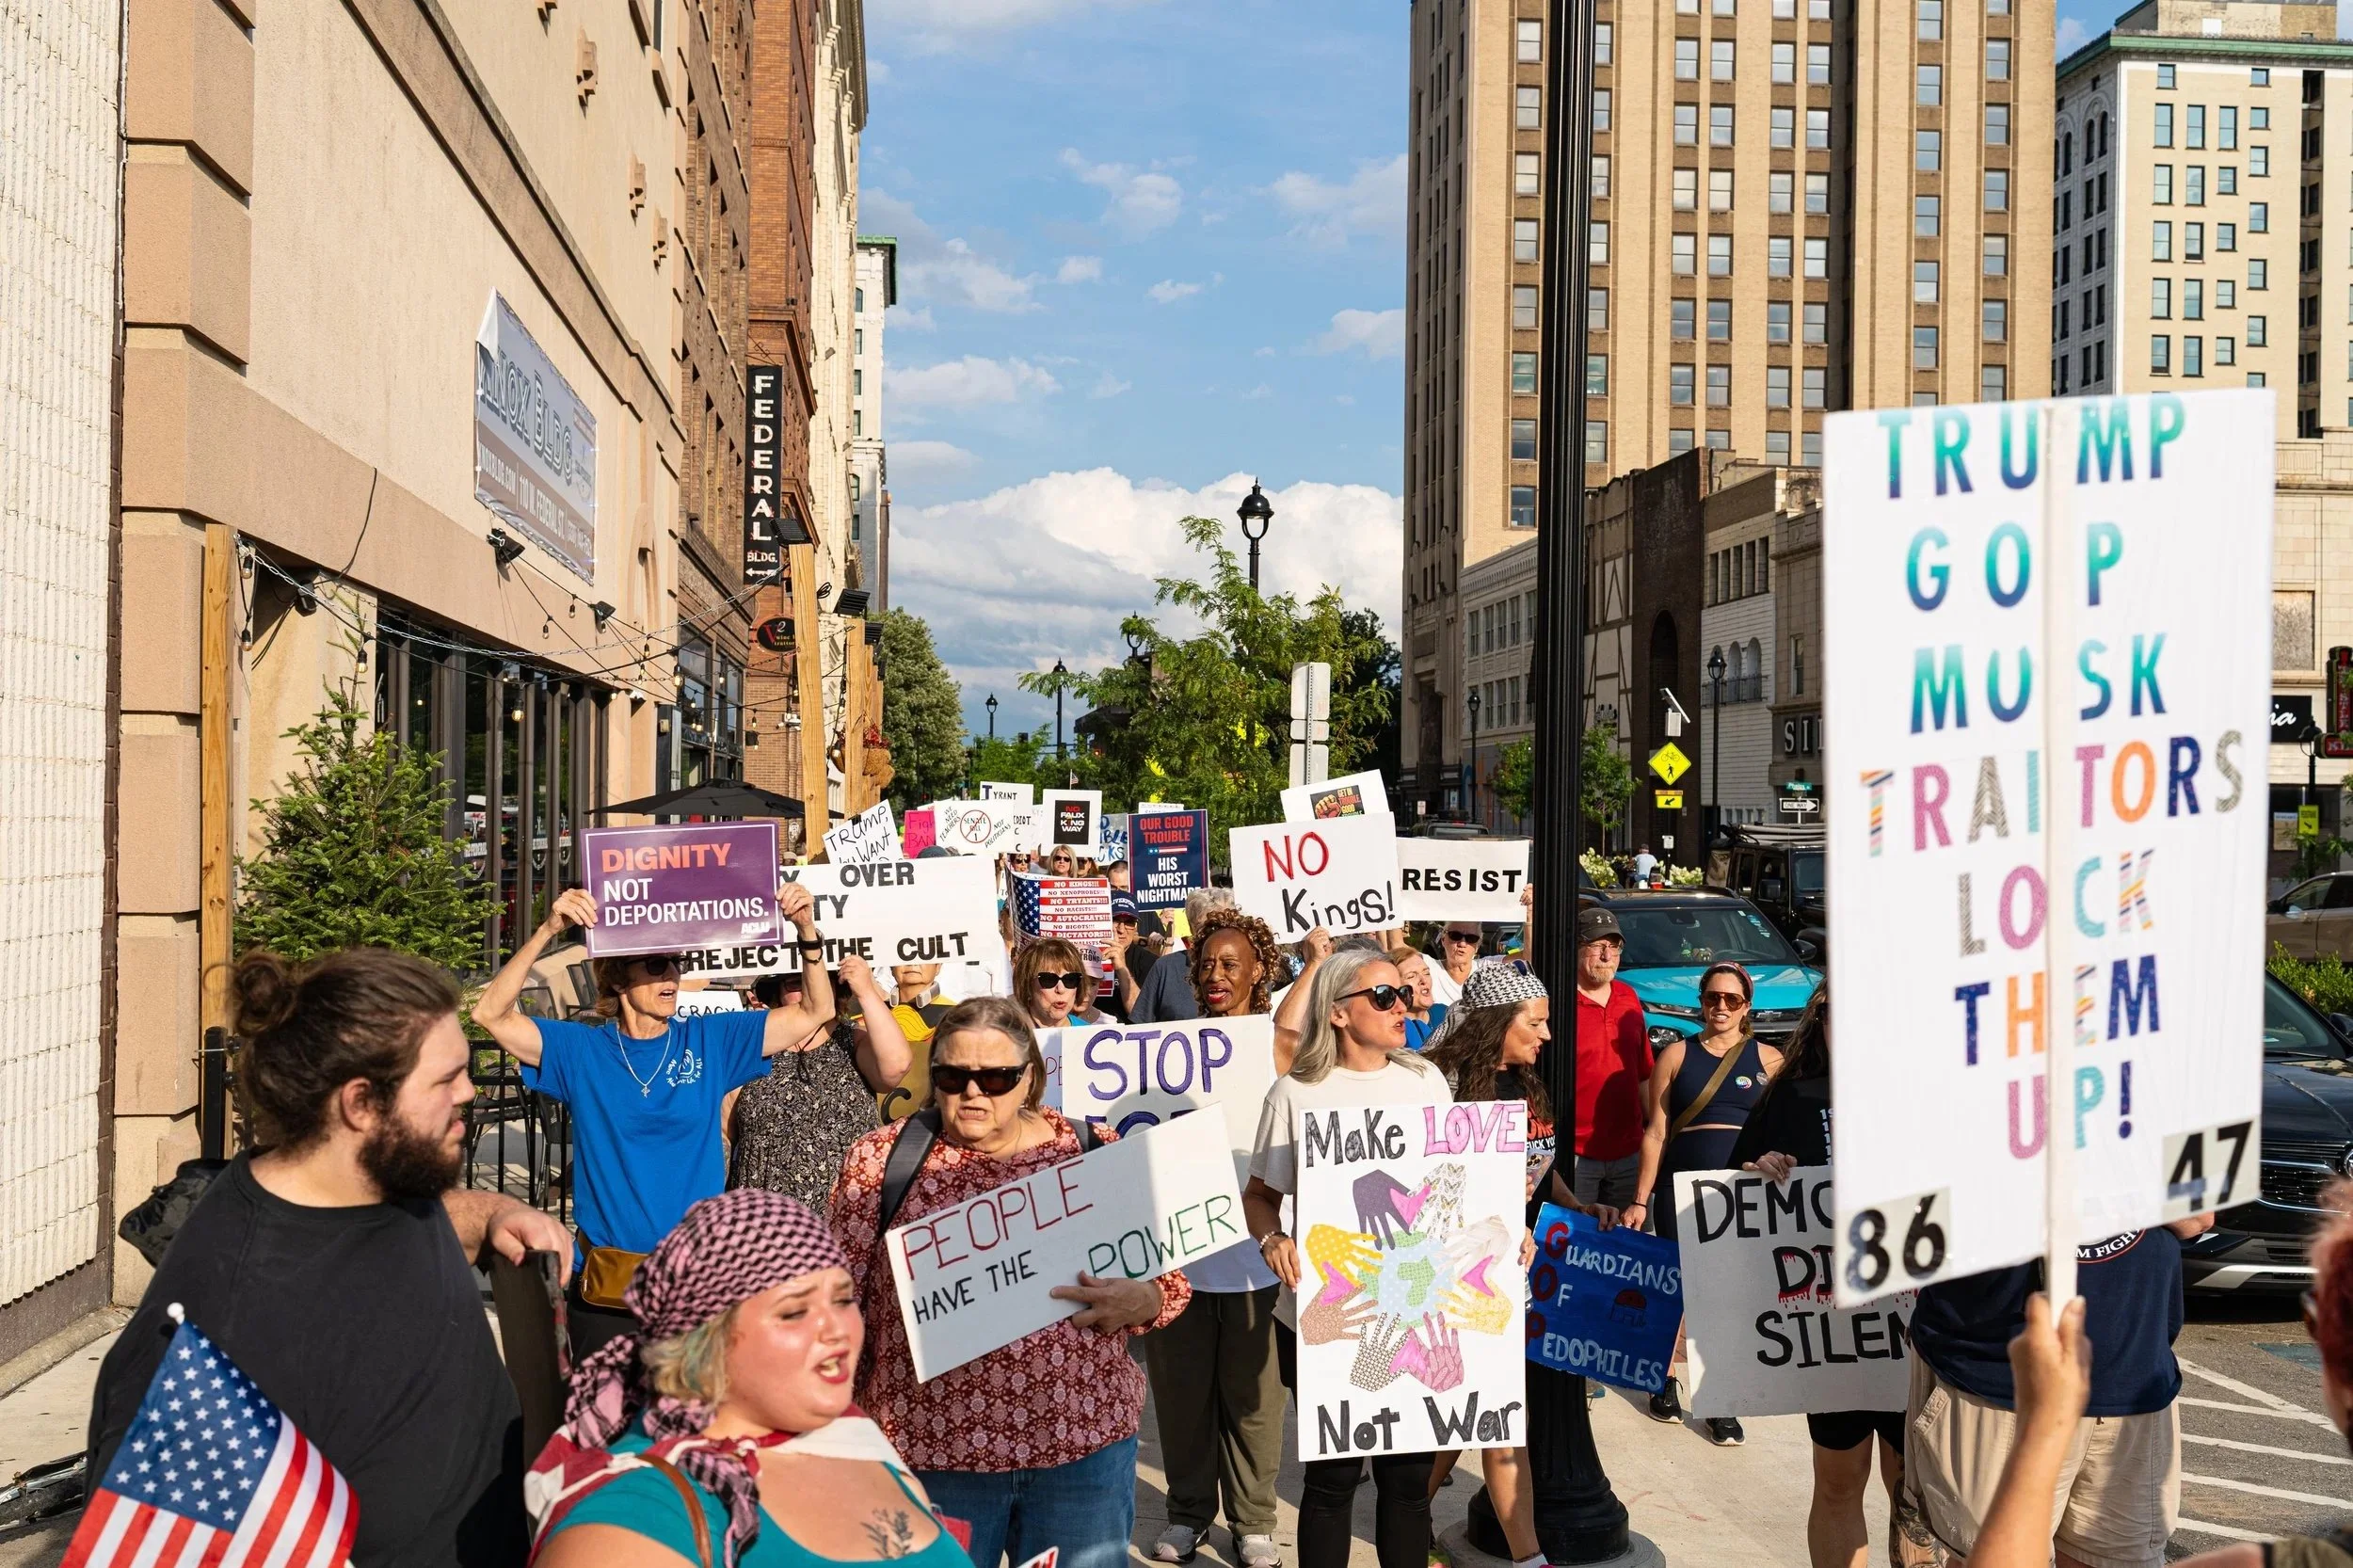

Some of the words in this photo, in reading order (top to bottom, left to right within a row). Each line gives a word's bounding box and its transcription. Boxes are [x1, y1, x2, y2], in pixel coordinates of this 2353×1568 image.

[752, 376, 775, 541] FEDERAL
[1879, 395, 2185, 499] TRUMP
[747, 552, 777, 563] BLDG.
[1906, 520, 2123, 612] GOP
[1910, 632, 2168, 735] MUSK
[1140, 818, 1161, 830] OUR
[1164, 815, 1194, 829] GOOD
[1860, 729, 2244, 857] TRAITORS
[601, 843, 732, 872] DIGNITY
[1144, 829, 1191, 844] TROUBLE
[1158, 856, 1177, 872] HIS
[1263, 832, 1329, 883] NO
[603, 878, 653, 903] NOT
[840, 861, 915, 888] OVER
[1137, 887, 1202, 904] NIGHTMA
[1147, 872, 1189, 888] WORST
[1402, 868, 1522, 893] RESIST
[1958, 849, 2155, 958] LOCK
[604, 897, 770, 927] DEPORTATIONS.
[688, 942, 798, 972] REJECT
[824, 936, 874, 963] THE
[896, 931, 968, 962] CULT
[1955, 954, 2160, 1065] THEM
[1084, 1028, 1233, 1101] STOP
[1422, 1103, 1526, 1157] LOVE
[2008, 1060, 2134, 1160] UP!
[2168, 1121, 2254, 1214] 47
[902, 1160, 1094, 1281] PEOPLE
[1088, 1194, 1238, 1279] POWER
[1846, 1193, 1946, 1293] 86
[911, 1276, 975, 1325] HAVE
[985, 1248, 1039, 1293] THE
[1533, 1263, 1574, 1307] OF
[1545, 1222, 1682, 1295] GUARDIANS
[1526, 1311, 1663, 1391] PEDOPHILES
[1318, 1400, 1401, 1455] Not
[1423, 1391, 1522, 1447] War
